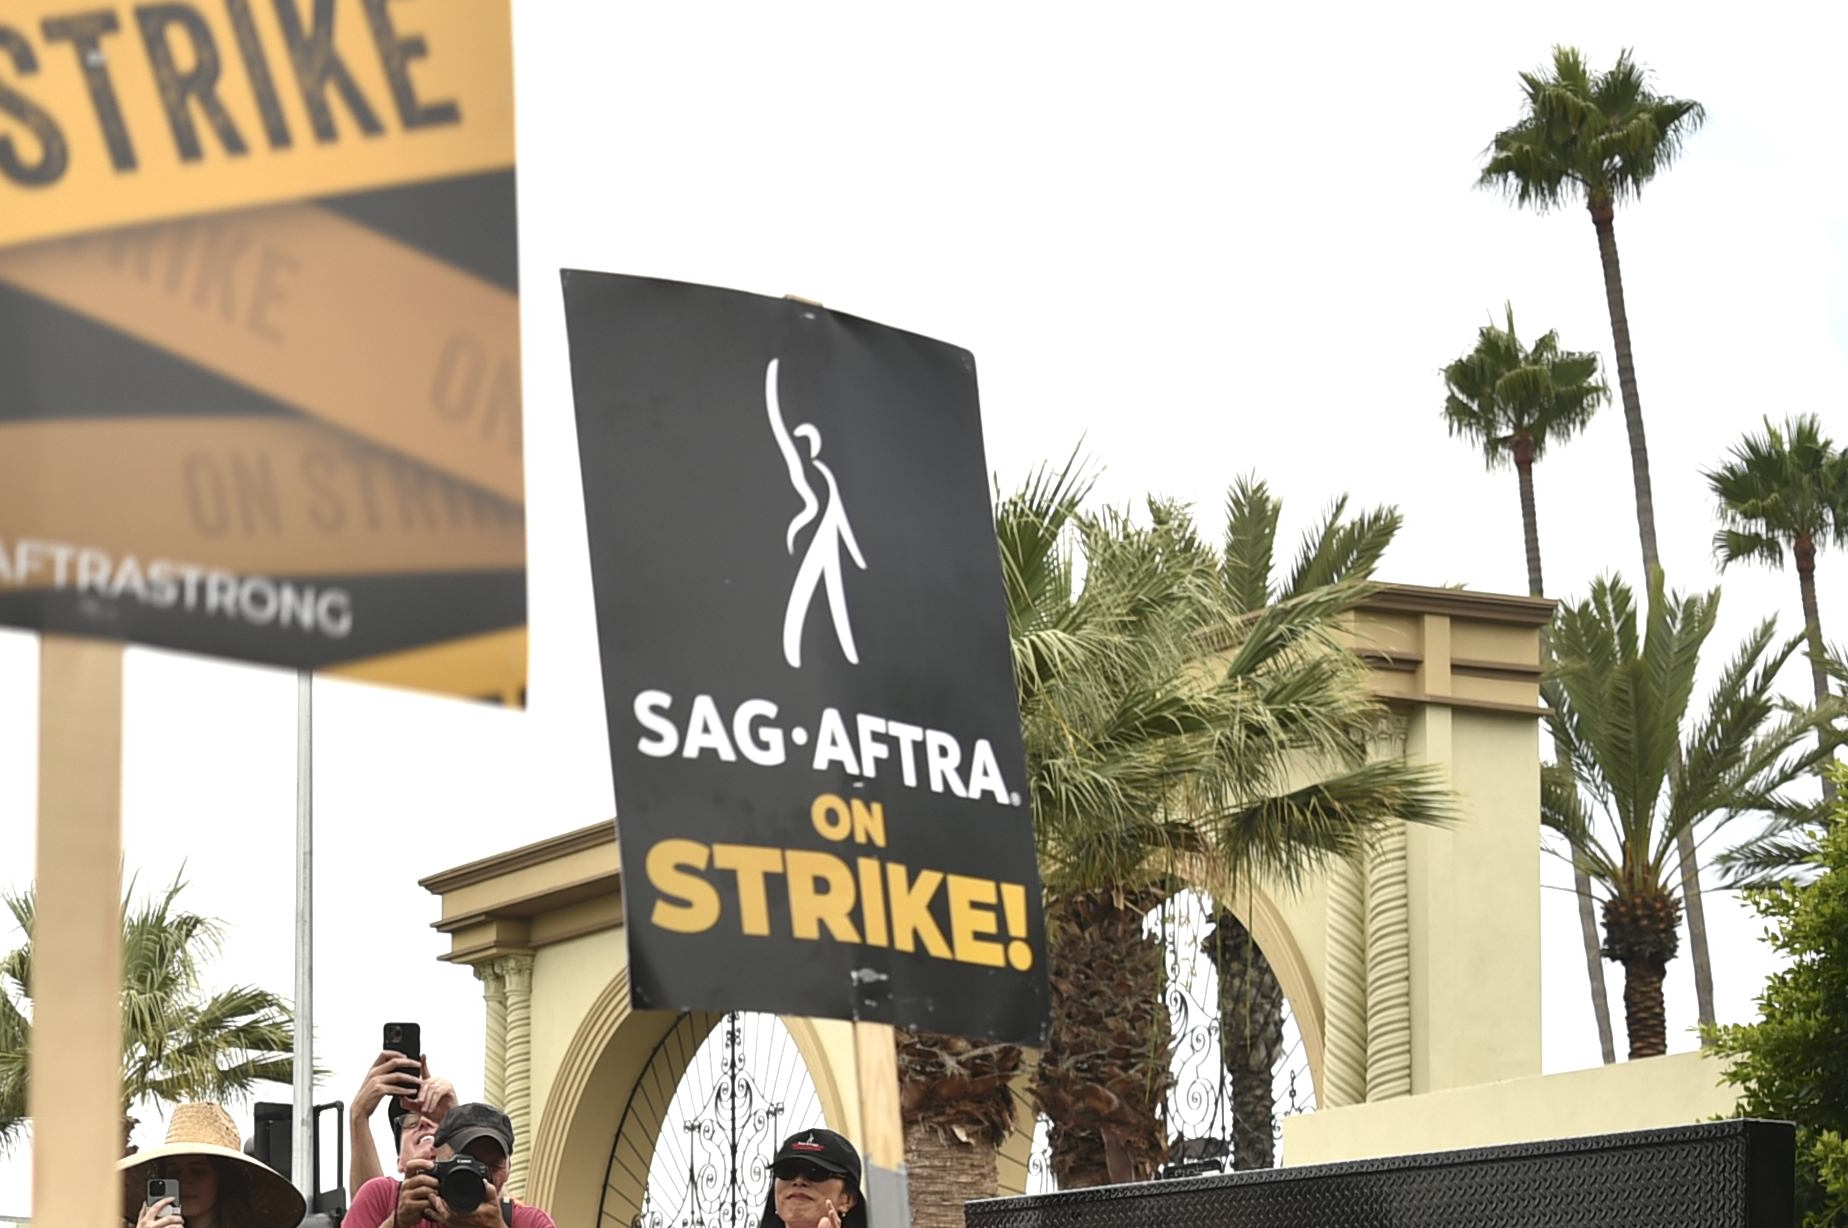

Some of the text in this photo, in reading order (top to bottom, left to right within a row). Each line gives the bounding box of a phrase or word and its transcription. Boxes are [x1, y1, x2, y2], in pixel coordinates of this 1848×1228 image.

[179, 446, 283, 541] ON
[811, 793, 887, 848] ON
[645, 837, 1034, 972] STRIKE!
